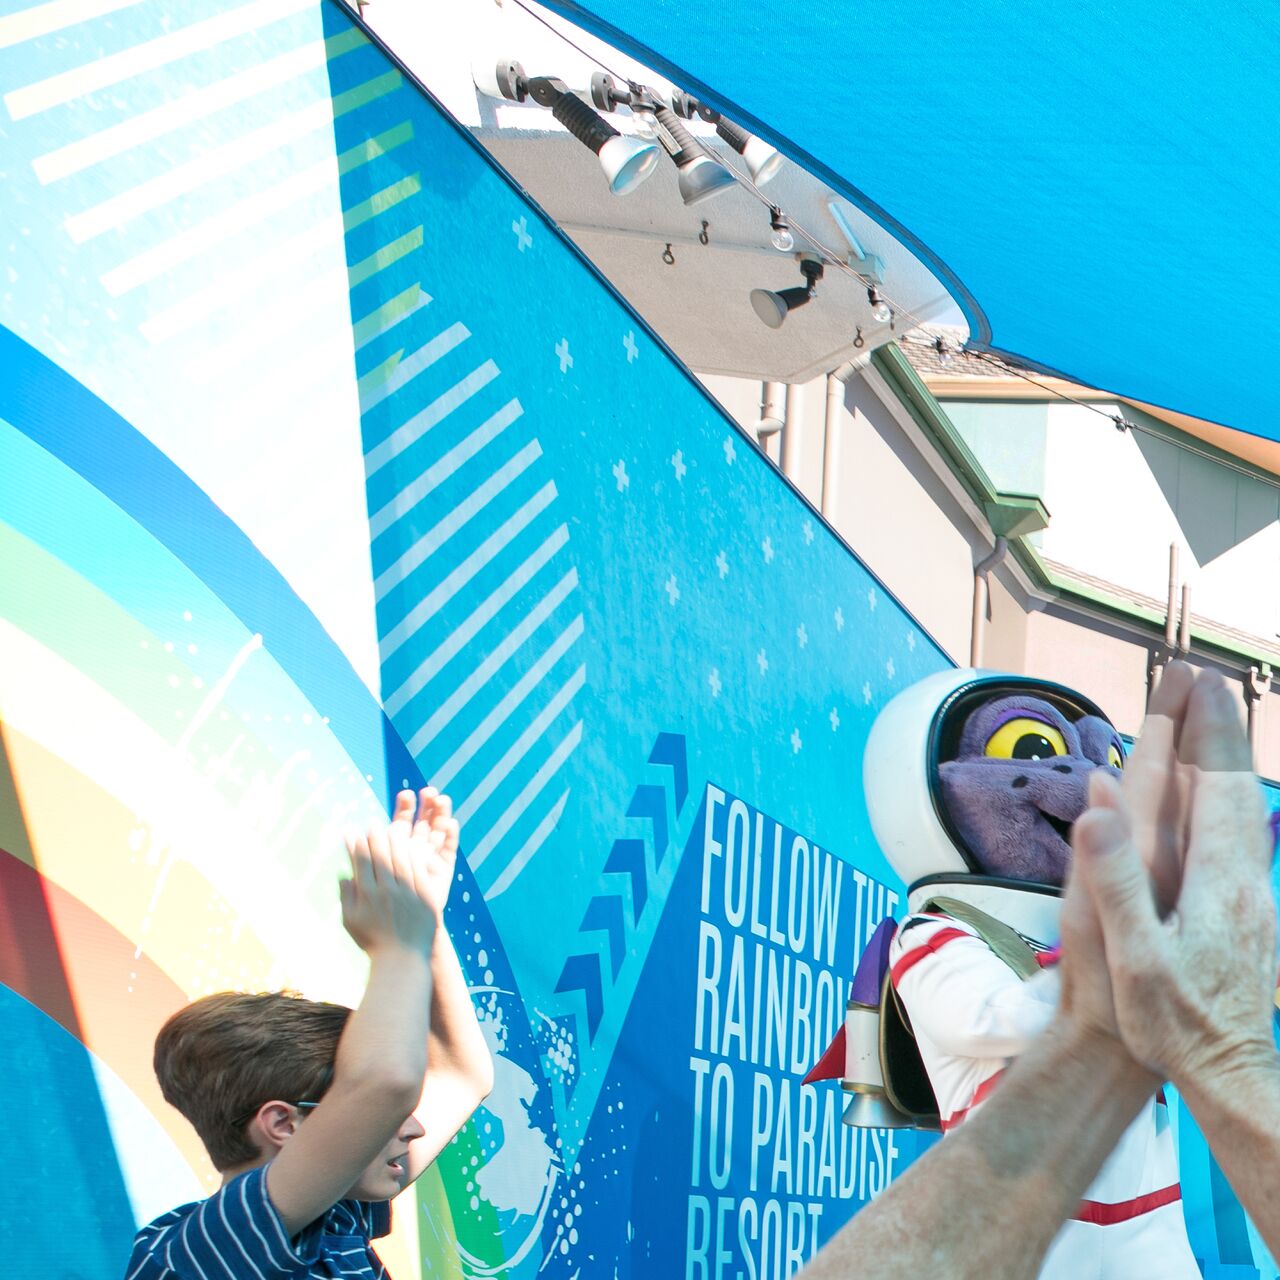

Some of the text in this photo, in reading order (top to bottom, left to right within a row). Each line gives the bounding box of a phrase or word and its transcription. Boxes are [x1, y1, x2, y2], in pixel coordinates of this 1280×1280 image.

[701, 783, 843, 967] FOLLOW
[694, 919, 853, 1084] RAINBO
[689, 1056, 735, 1190] TO
